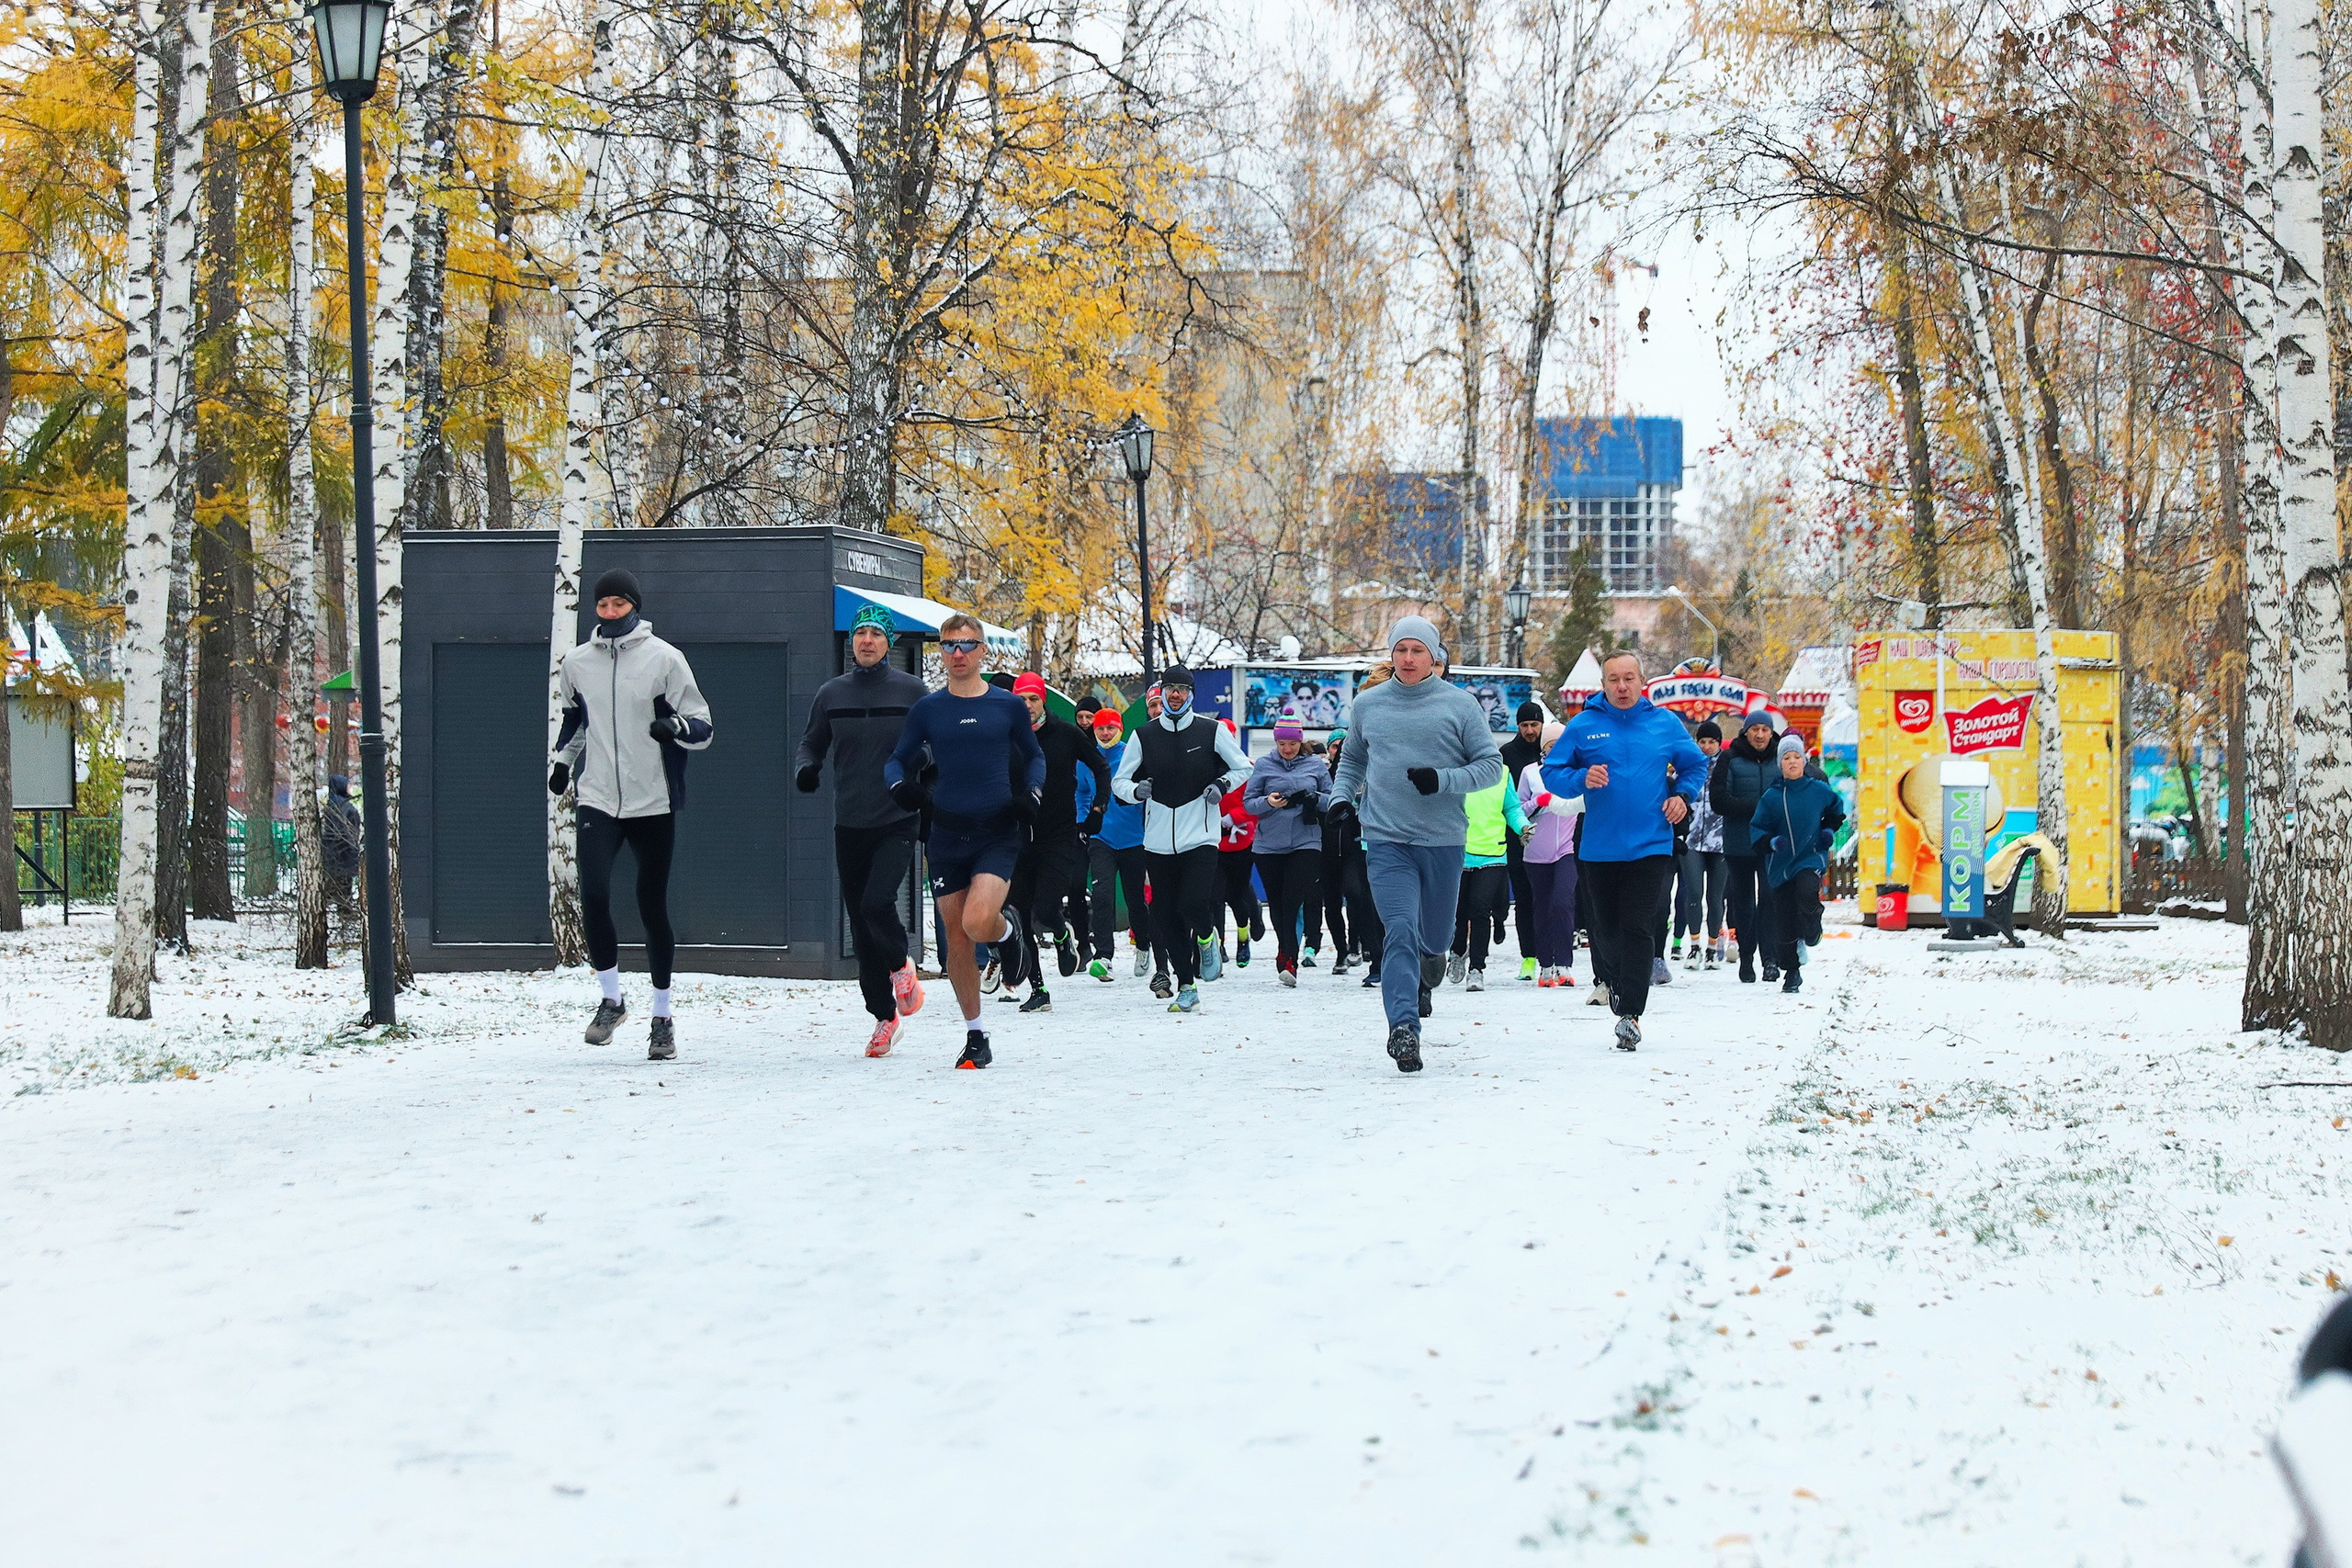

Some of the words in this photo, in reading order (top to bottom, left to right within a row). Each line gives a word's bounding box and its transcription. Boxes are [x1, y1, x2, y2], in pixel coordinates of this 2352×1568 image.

[848, 551, 880, 575] СУВЕНИРЫ
[1953, 706, 2019, 734] Золотой
[1587, 732, 1611, 740] KELME
[1952, 725, 2020, 747] Стандарт
[1950, 791, 1971, 912] КОРМ
